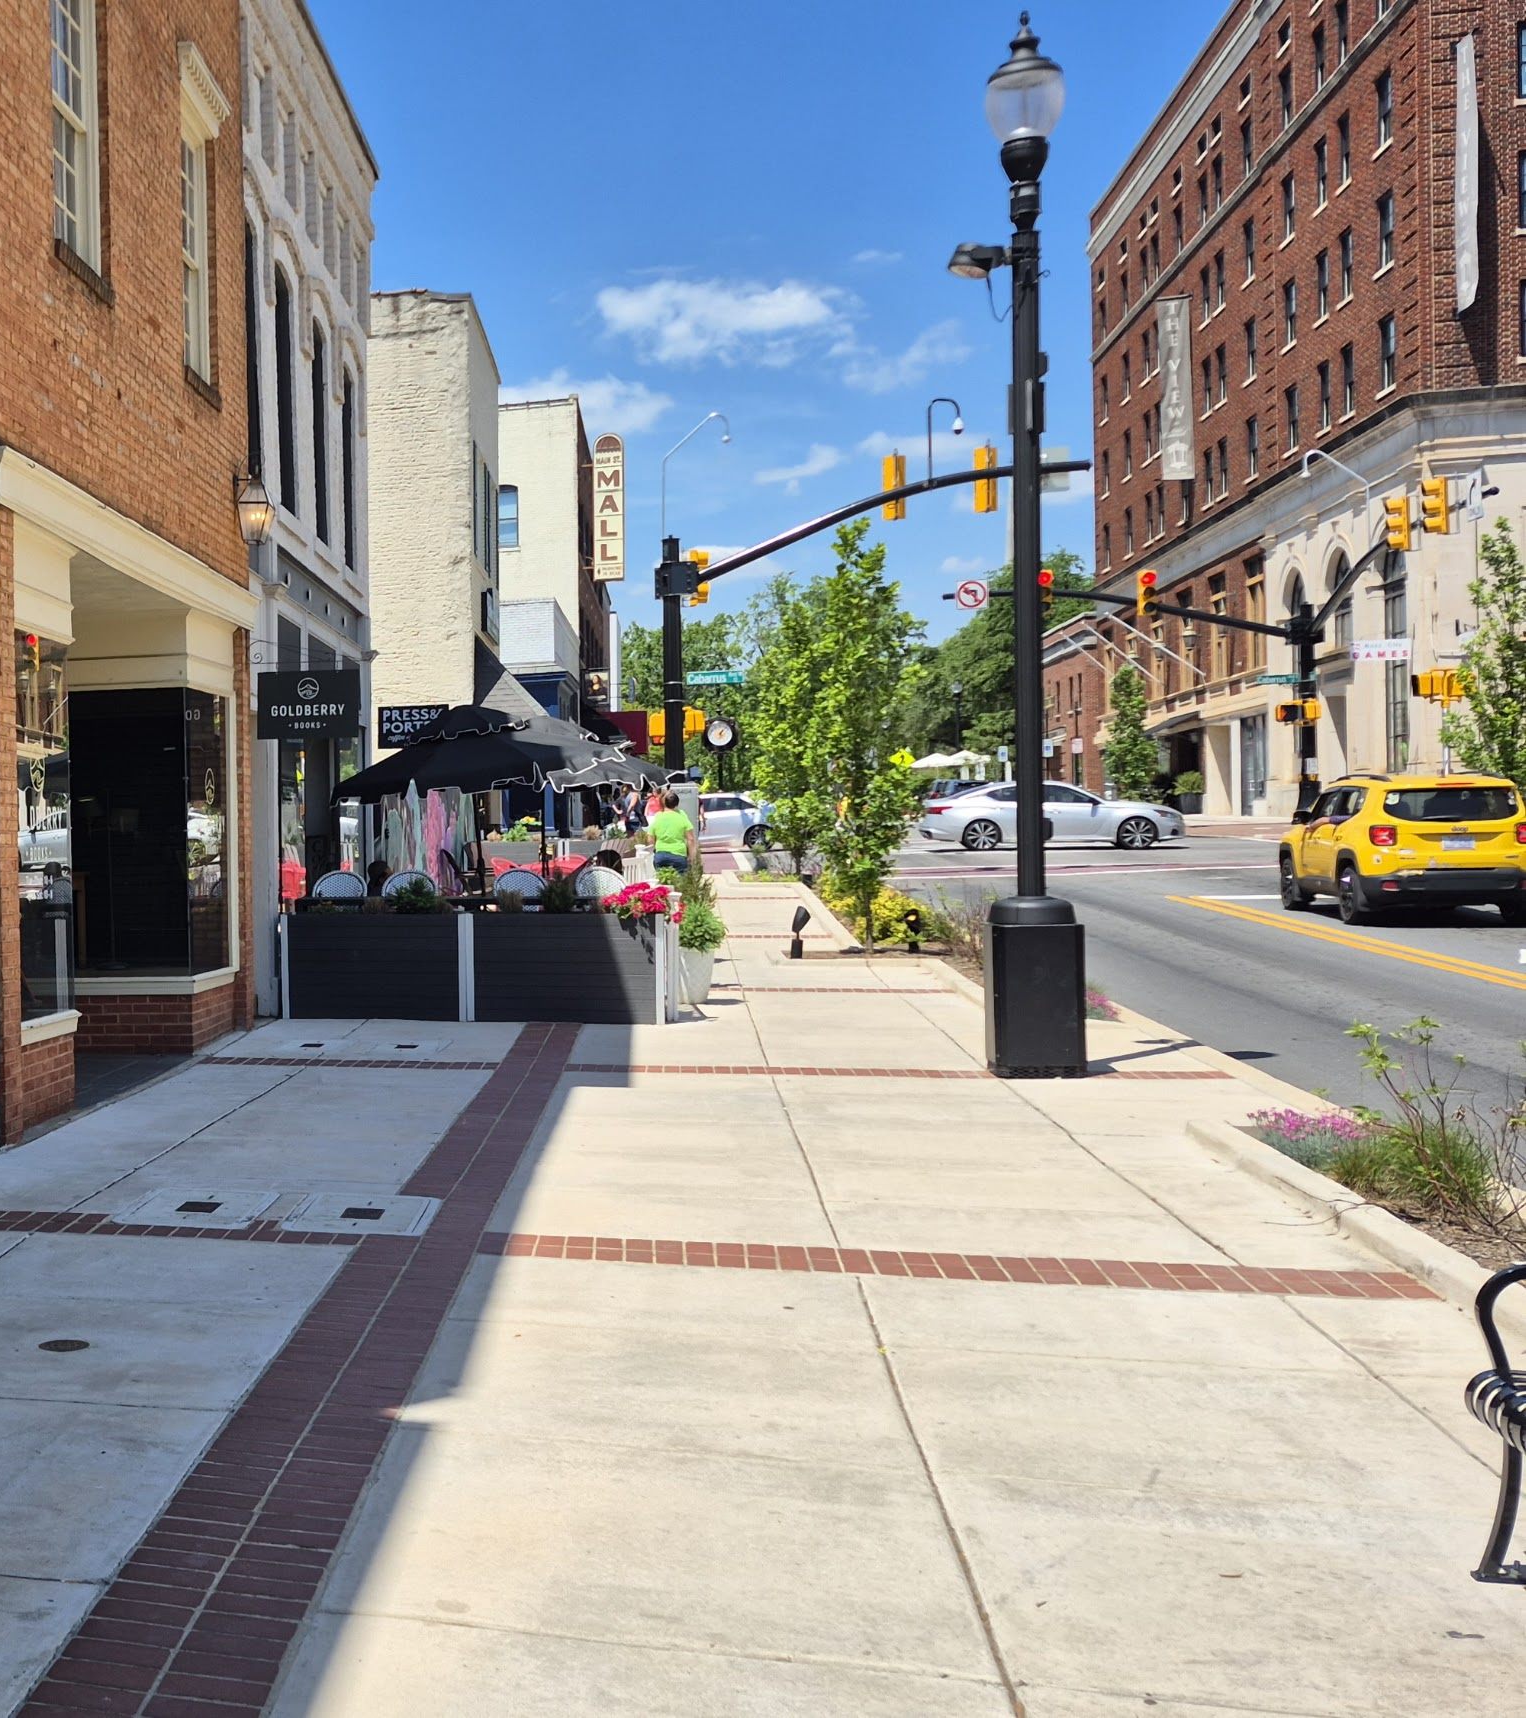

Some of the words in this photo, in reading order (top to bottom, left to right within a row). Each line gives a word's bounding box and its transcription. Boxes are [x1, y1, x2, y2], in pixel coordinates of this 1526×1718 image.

[595, 457, 611, 465] MAIN
[597, 469, 620, 561] MALL
[1352, 650, 1409, 660] GAMES
[688, 674, 727, 685] Cabarrus
[270, 703, 345, 717] GOLDBERRY
[294, 721, 321, 729] BOOKS
